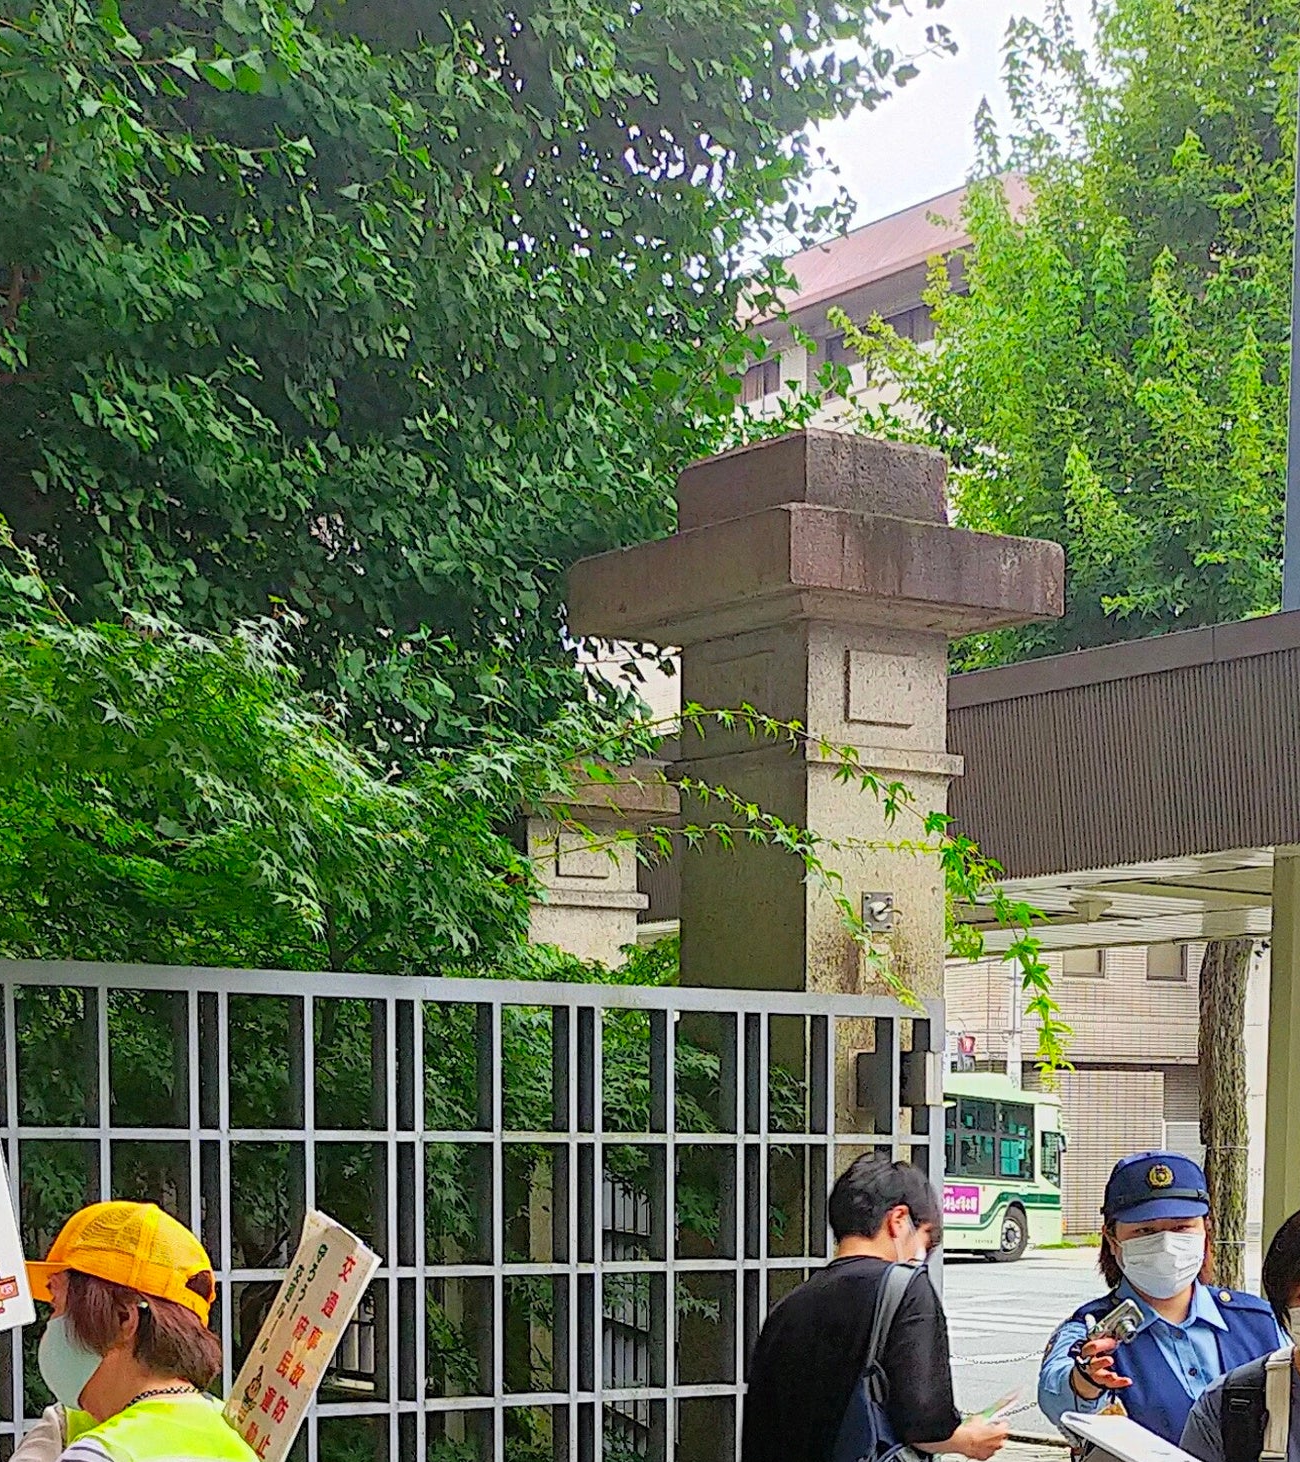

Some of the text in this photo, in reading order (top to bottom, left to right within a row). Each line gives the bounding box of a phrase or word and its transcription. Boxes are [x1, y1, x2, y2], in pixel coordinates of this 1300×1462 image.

[254, 1254, 357, 1460] 交通事故防止
[259, 1263, 306, 1355] 交通ルール
[244, 1314, 311, 1447] 府民運動
